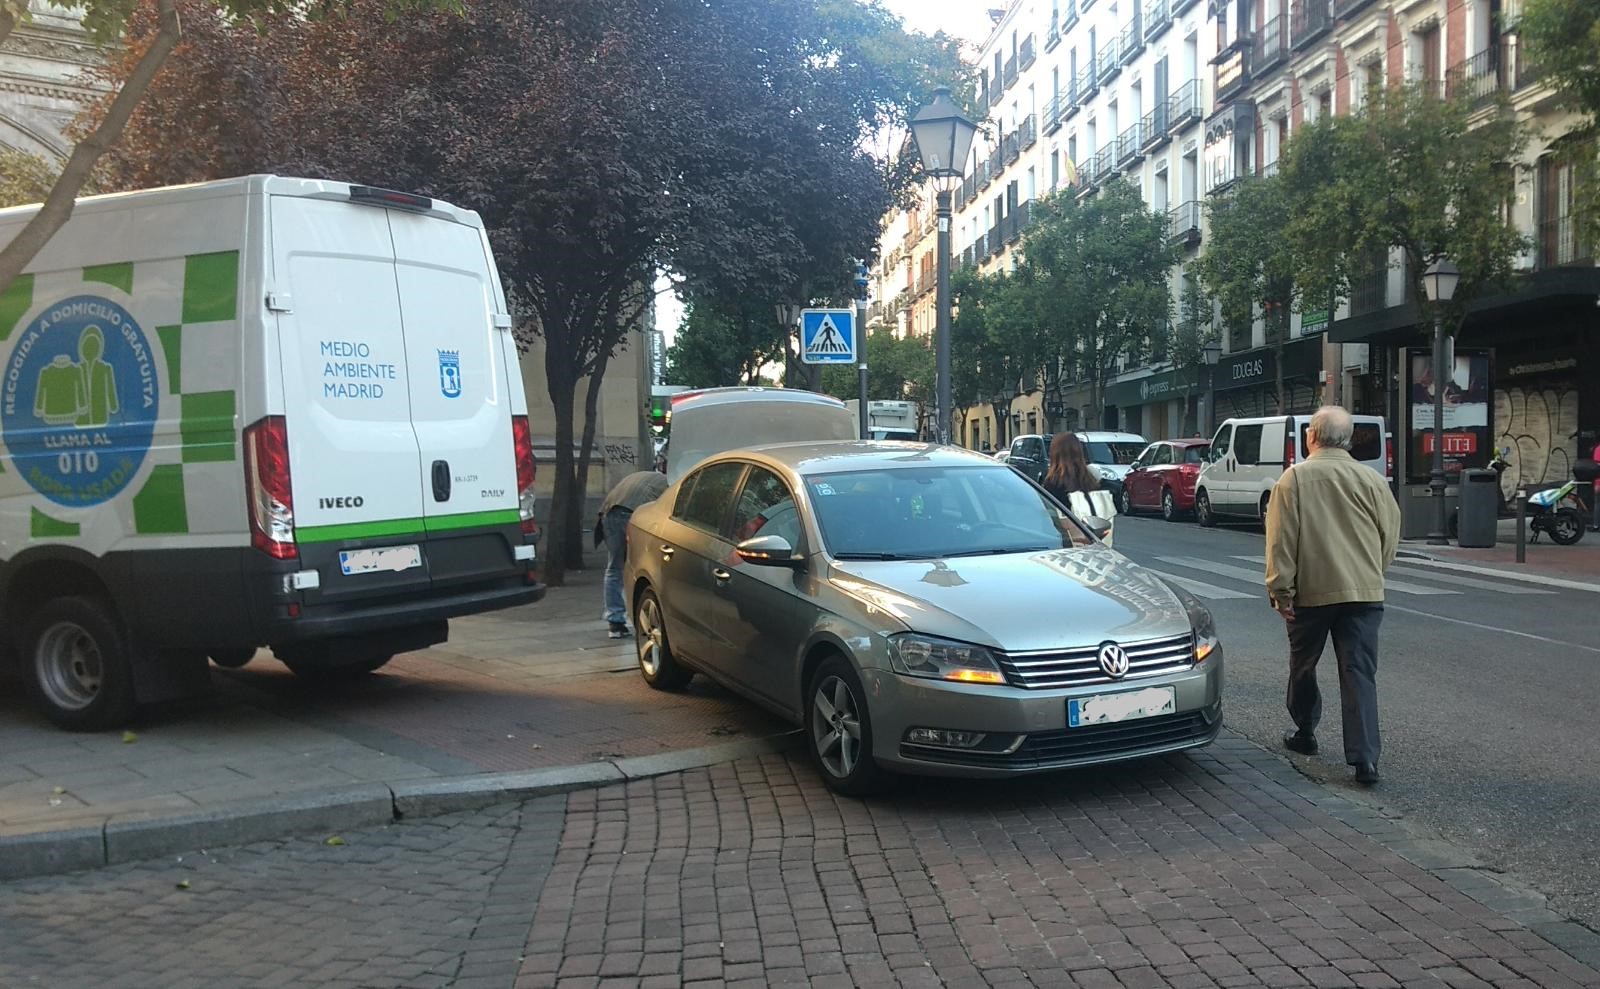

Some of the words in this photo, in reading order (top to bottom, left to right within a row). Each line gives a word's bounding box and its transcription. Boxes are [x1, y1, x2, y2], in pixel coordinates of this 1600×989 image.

[320, 341, 370, 358] MEDIO
[6, 331, 39, 416] RECOGIDA
[40, 319, 51, 333] A
[52, 302, 121, 326] DOMICILIO
[121, 323, 153, 409] GRATUITA
[323, 362, 396, 379] AMBIENTE
[1232, 359, 1263, 380] DOUGLAS
[323, 383, 384, 399] MADRID
[1149, 381, 1169, 397] express
[44, 433, 91, 448] LLAMA
[94, 432, 112, 445] AL
[59, 452, 98, 474] 010
[481, 489, 505, 498] DAILY
[319, 496, 364, 509] IVECO
